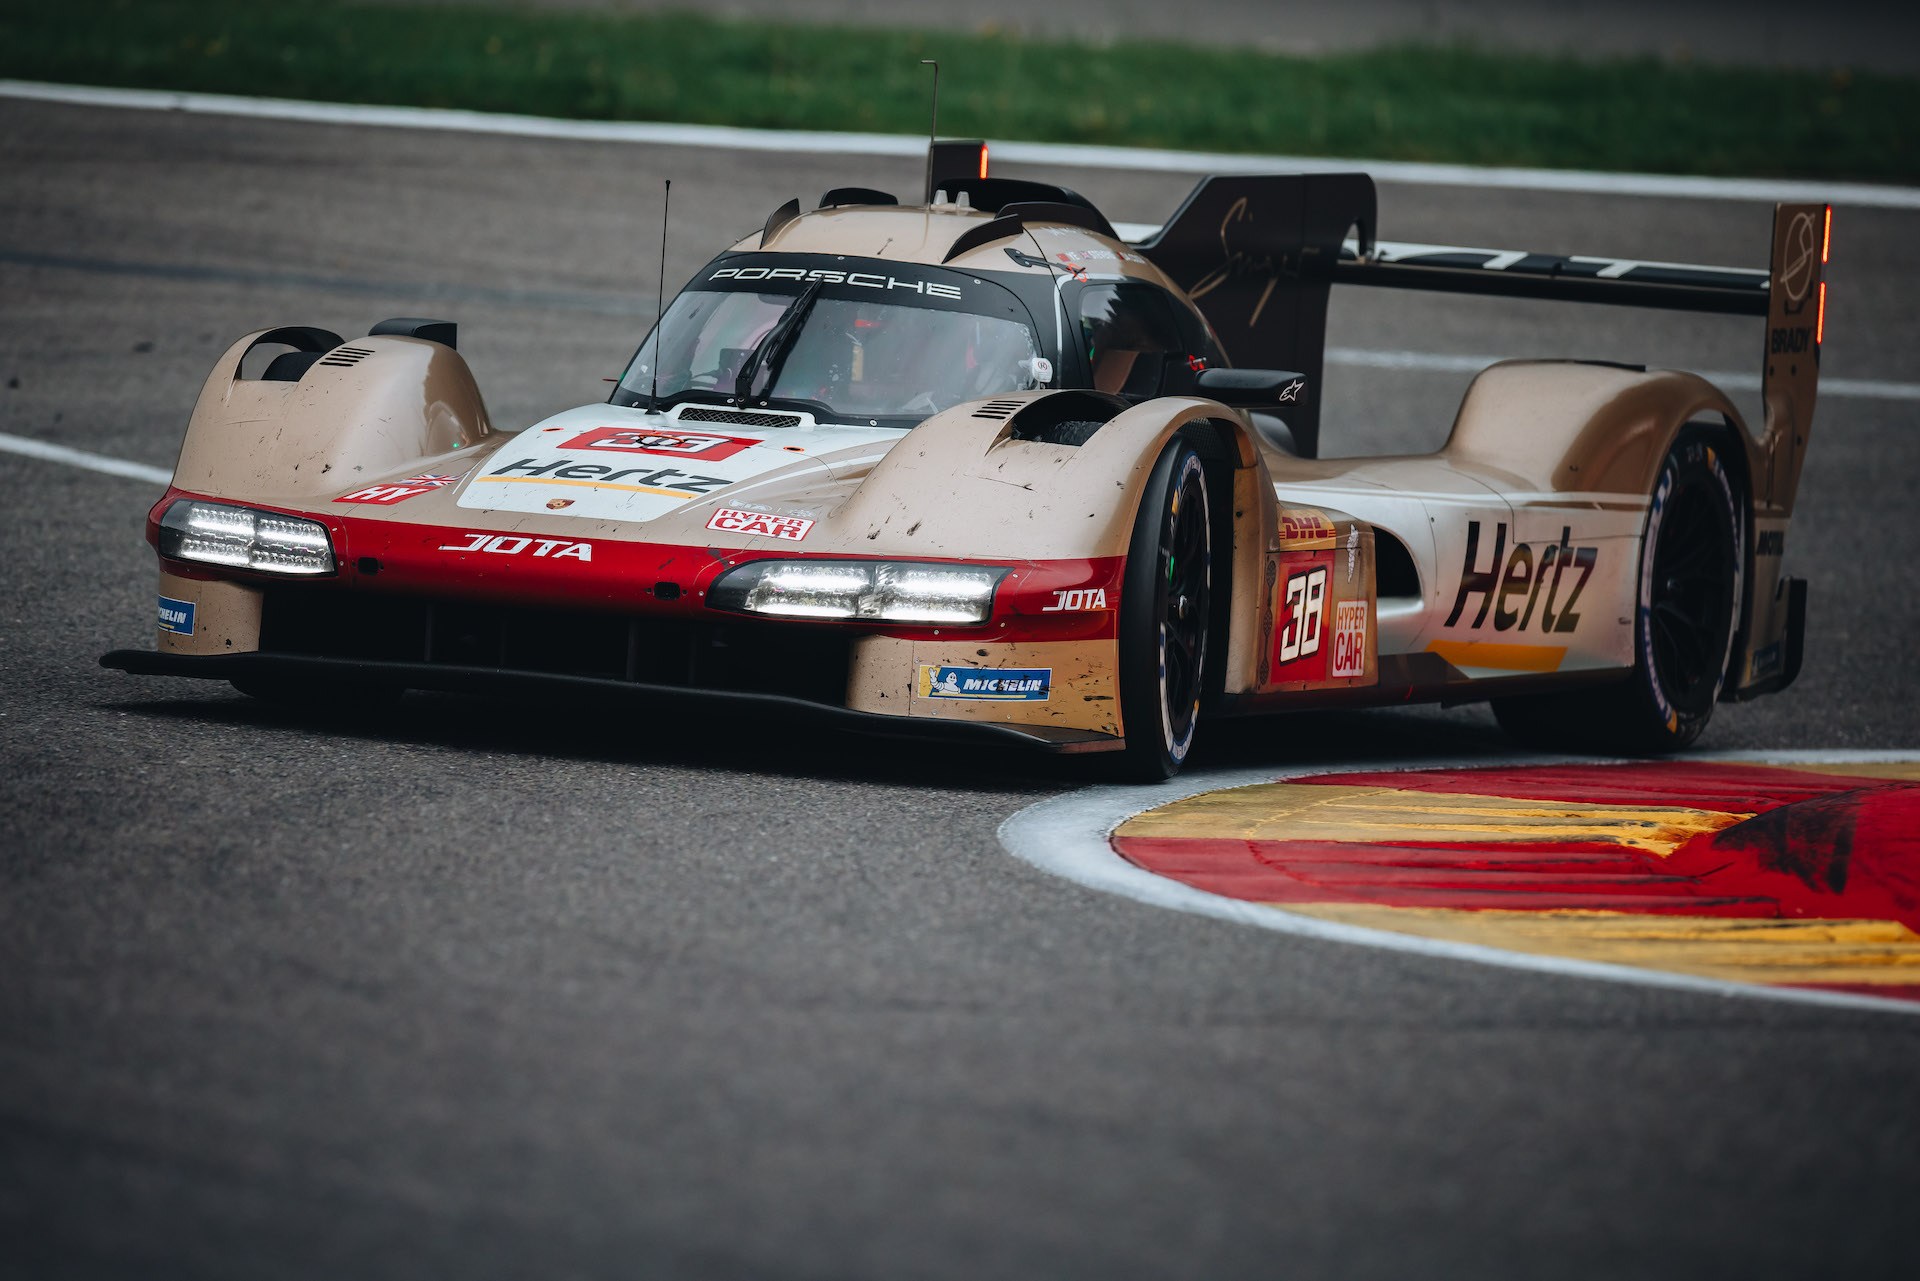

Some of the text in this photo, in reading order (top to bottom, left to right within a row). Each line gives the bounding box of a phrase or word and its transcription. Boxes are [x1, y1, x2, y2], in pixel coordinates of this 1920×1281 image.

[709, 267, 962, 300] PORSCHE
[1771, 328, 1810, 354] BRADY
[490, 458, 734, 494] Hertz
[343, 486, 429, 501] HY
[714, 517, 801, 538] CAR
[720, 510, 804, 527] HYPER
[1281, 516, 1329, 540] DHL
[437, 533, 592, 562] JOTA
[1443, 521, 1599, 634] Hertz
[1042, 588, 1107, 612] JOTA
[1279, 565, 1328, 668] 38
[1337, 606, 1365, 630] HYPER
[1334, 631, 1364, 672] CAR
[963, 678, 1043, 692] MICHELIN
